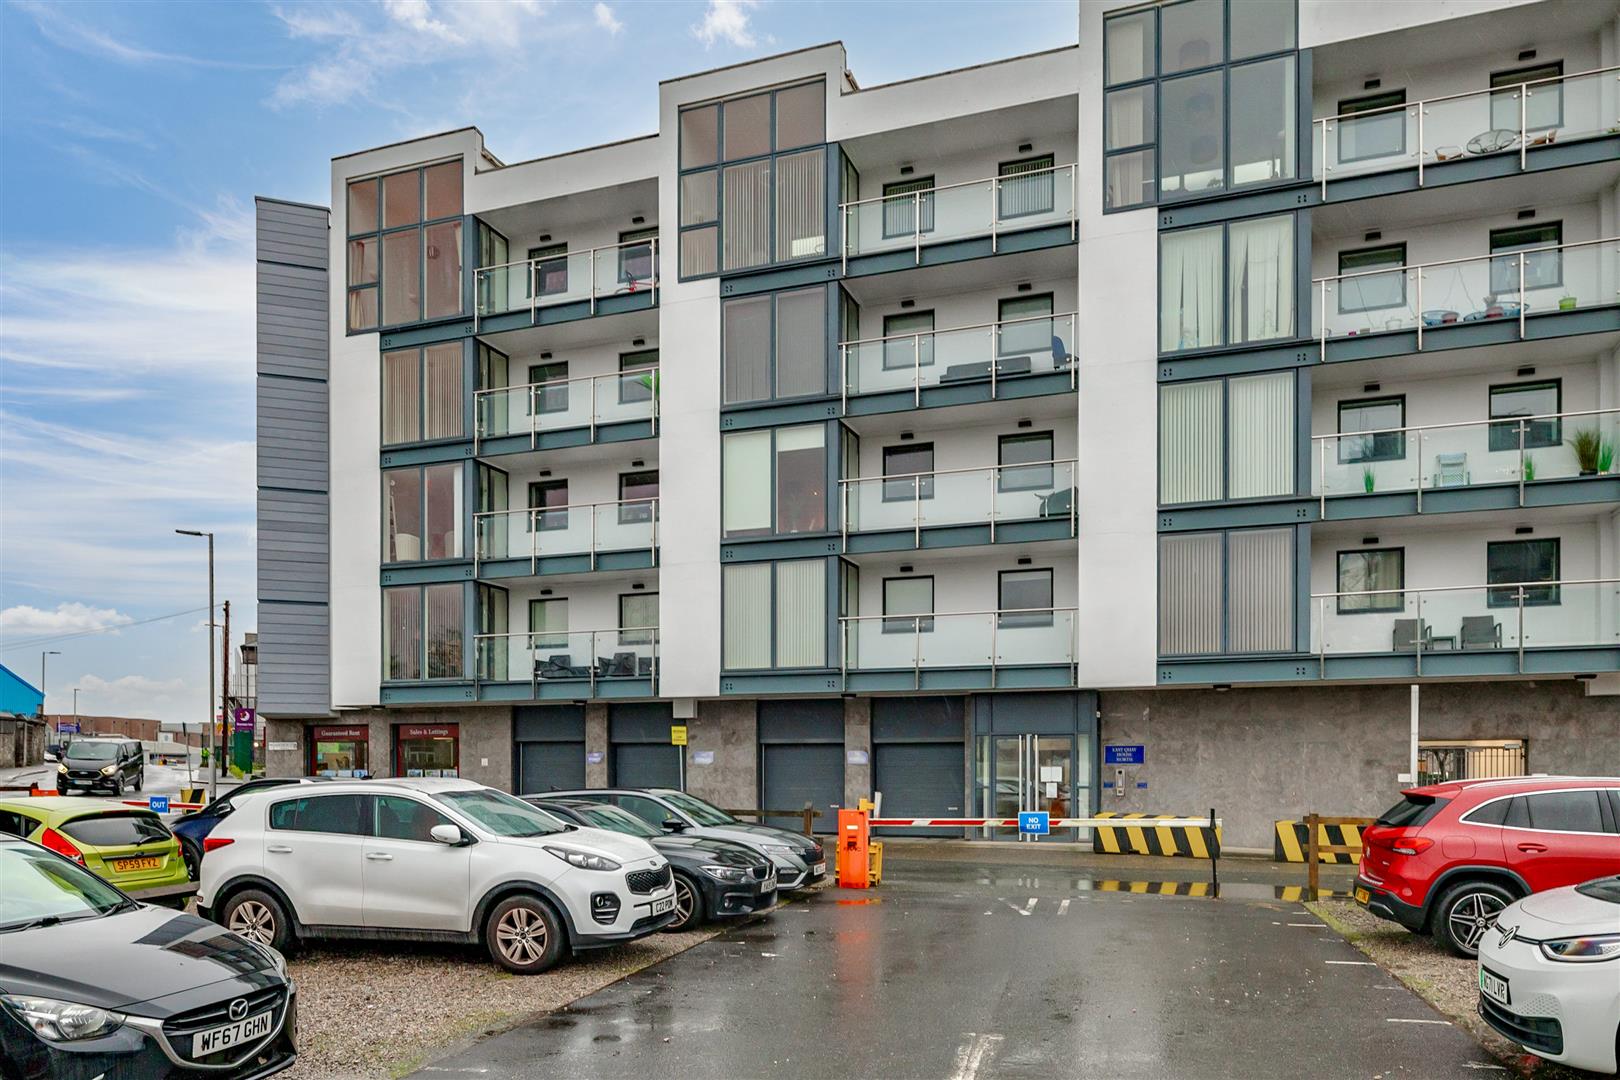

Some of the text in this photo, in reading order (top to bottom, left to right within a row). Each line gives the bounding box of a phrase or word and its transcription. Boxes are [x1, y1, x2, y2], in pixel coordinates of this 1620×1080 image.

[117, 859, 140, 870] SP59
[201, 1015, 268, 1051] WF67 GHN
